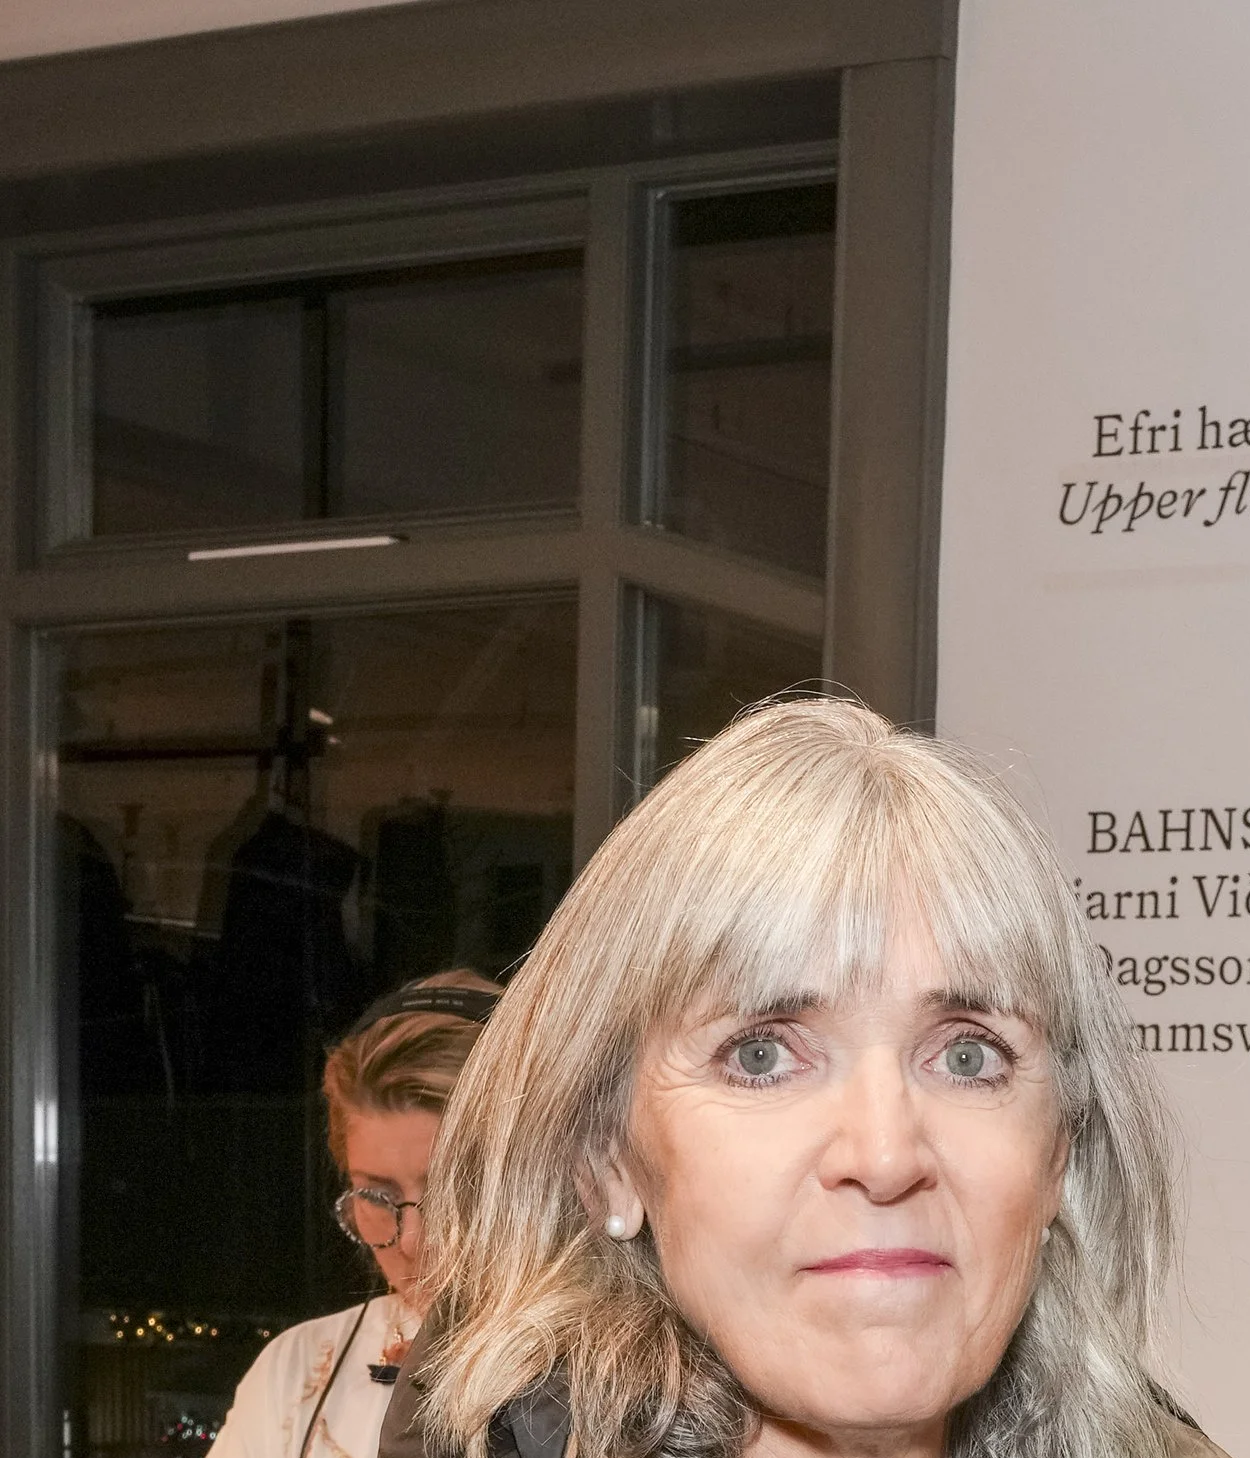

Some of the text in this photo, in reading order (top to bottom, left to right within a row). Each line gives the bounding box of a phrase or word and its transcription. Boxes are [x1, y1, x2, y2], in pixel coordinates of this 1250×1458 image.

[1092, 409, 1182, 458] Efri
[1058, 480, 1207, 535] Upper
[1074, 875, 1180, 921] arni
